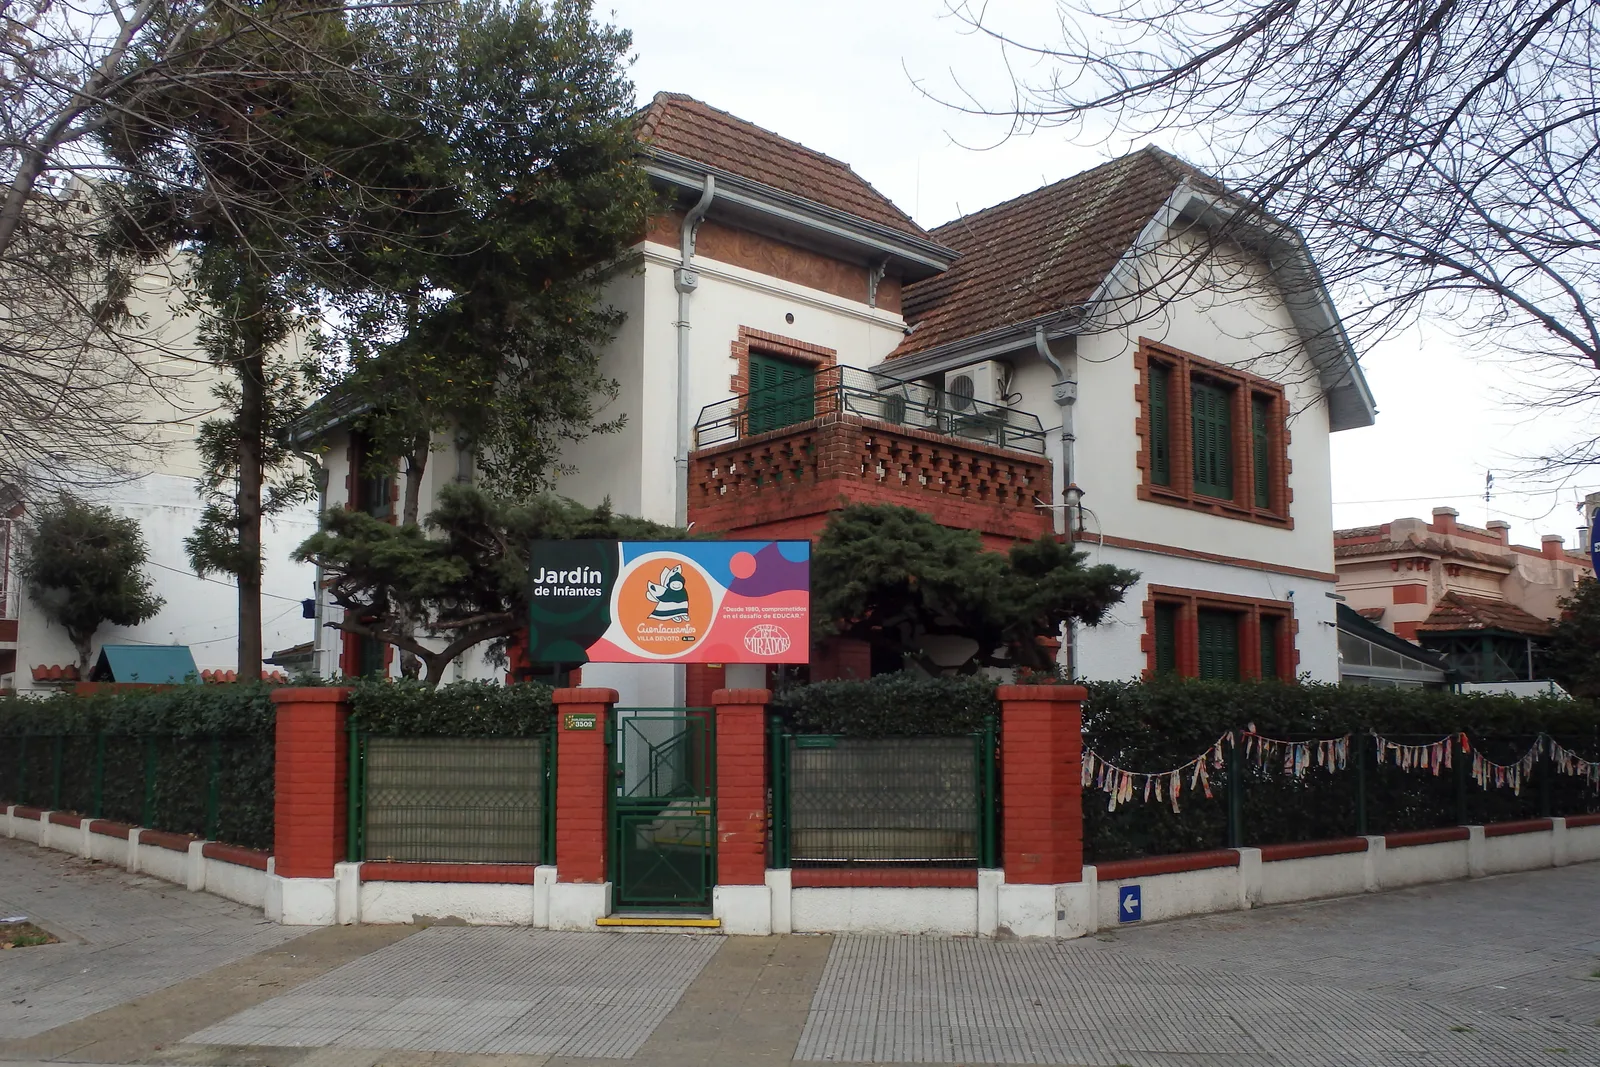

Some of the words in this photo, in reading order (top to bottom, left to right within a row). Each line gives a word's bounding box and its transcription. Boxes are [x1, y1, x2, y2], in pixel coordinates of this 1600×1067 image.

[533, 566, 602, 584] Jardín
[534, 585, 550, 596] de
[553, 585, 602, 596] Infantes
[637, 623, 697, 634] Cuentacuentos
[744, 637, 791, 655] MIRADOR
